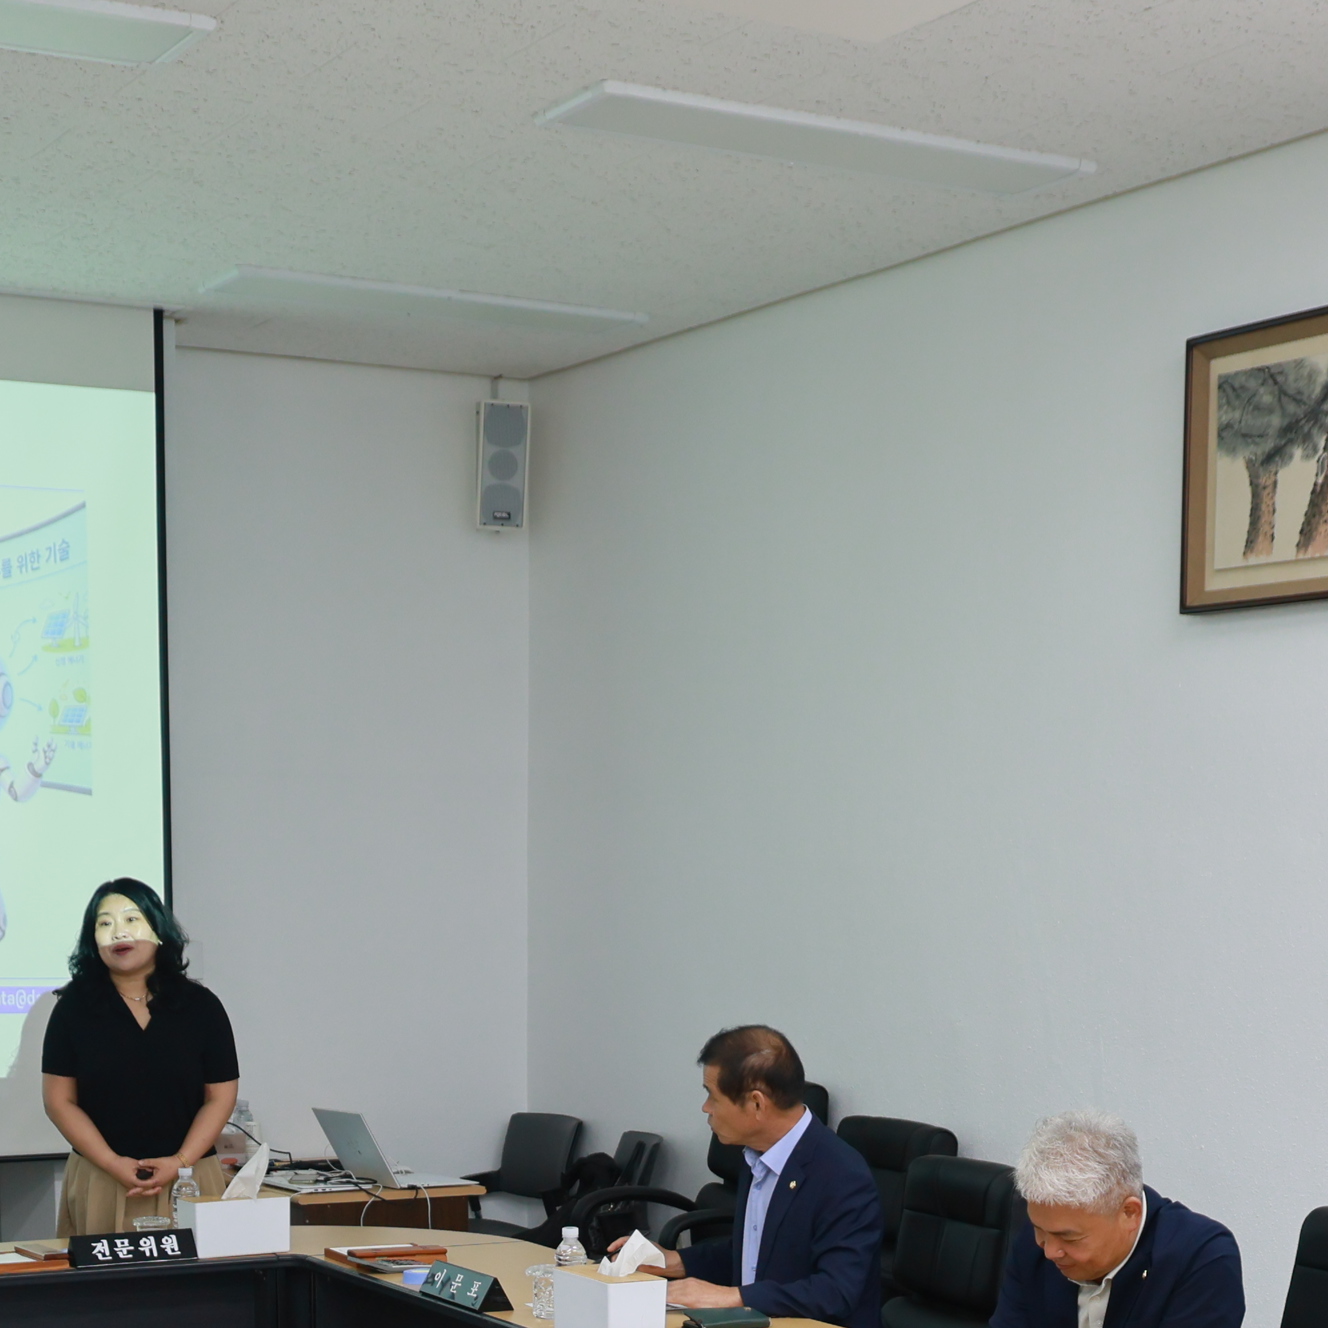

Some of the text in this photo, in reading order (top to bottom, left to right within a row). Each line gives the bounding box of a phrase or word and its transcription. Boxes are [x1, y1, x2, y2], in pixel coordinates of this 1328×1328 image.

[16, 550, 41, 574] 위한
[45, 538, 70, 564] 기술
[91, 1234, 181, 1260] 전문위원
[434, 1269, 482, 1297] 이문포
